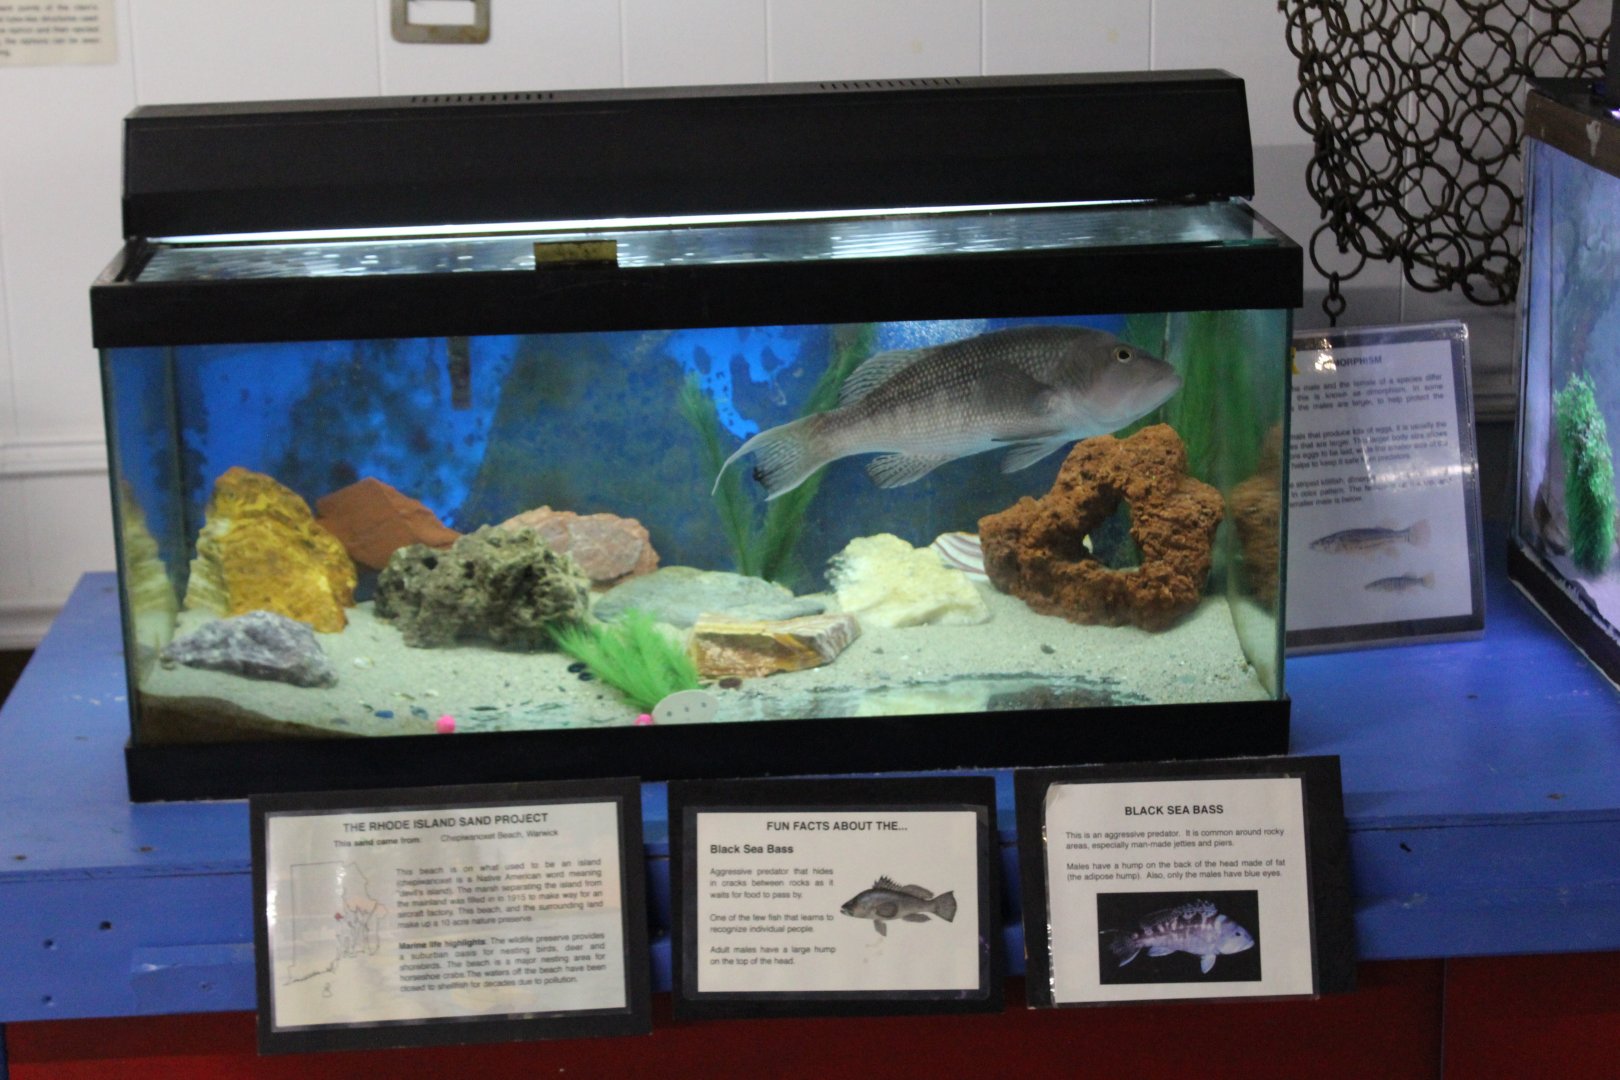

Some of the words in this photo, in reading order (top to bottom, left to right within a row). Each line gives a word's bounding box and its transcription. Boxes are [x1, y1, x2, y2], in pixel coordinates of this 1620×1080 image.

[1125, 806, 1164, 816] BLACK
[1167, 806, 1190, 815] SEA
[1193, 805, 1224, 814] BASS
[343, 822, 365, 833] THE
[369, 820, 410, 831] RHODE
[413, 818, 455, 829] ISLAND
[459, 816, 491, 827] SAND
[495, 813, 549, 826] PROJECT
[767, 822, 789, 830] FUN
[793, 822, 830, 830] FACTS
[833, 821, 872, 830] ABOUT
[876, 821, 908, 830] THE...
[354, 839, 374, 847] sand
[376, 838, 398, 846] came
[526, 829, 558, 837] Warwick
[1104, 831, 1146, 840] aggressive
[1264, 828, 1284, 837] rocky
[710, 845, 740, 853] Black
[743, 845, 763, 853] Sea
[767, 845, 794, 853] Bass
[1066, 843, 1090, 851] areas,
[1092, 841, 1129, 850] especially
[1173, 840, 1195, 849] jetties
[1122, 862, 1143, 870] hump
[1195, 860, 1202, 868] of
[1204, 860, 1216, 868] the
[1241, 859, 1263, 867] made
[710, 868, 752, 877] Aggressive
[757, 868, 789, 877] predator
[1067, 873, 1082, 882] (the
[1084, 872, 1114, 881] adipose
[1167, 871, 1183, 880] only
[1224, 870, 1242, 878] have
[791, 946, 810, 954] large
[814, 946, 836, 954] hump
[736, 958, 747, 966] top
